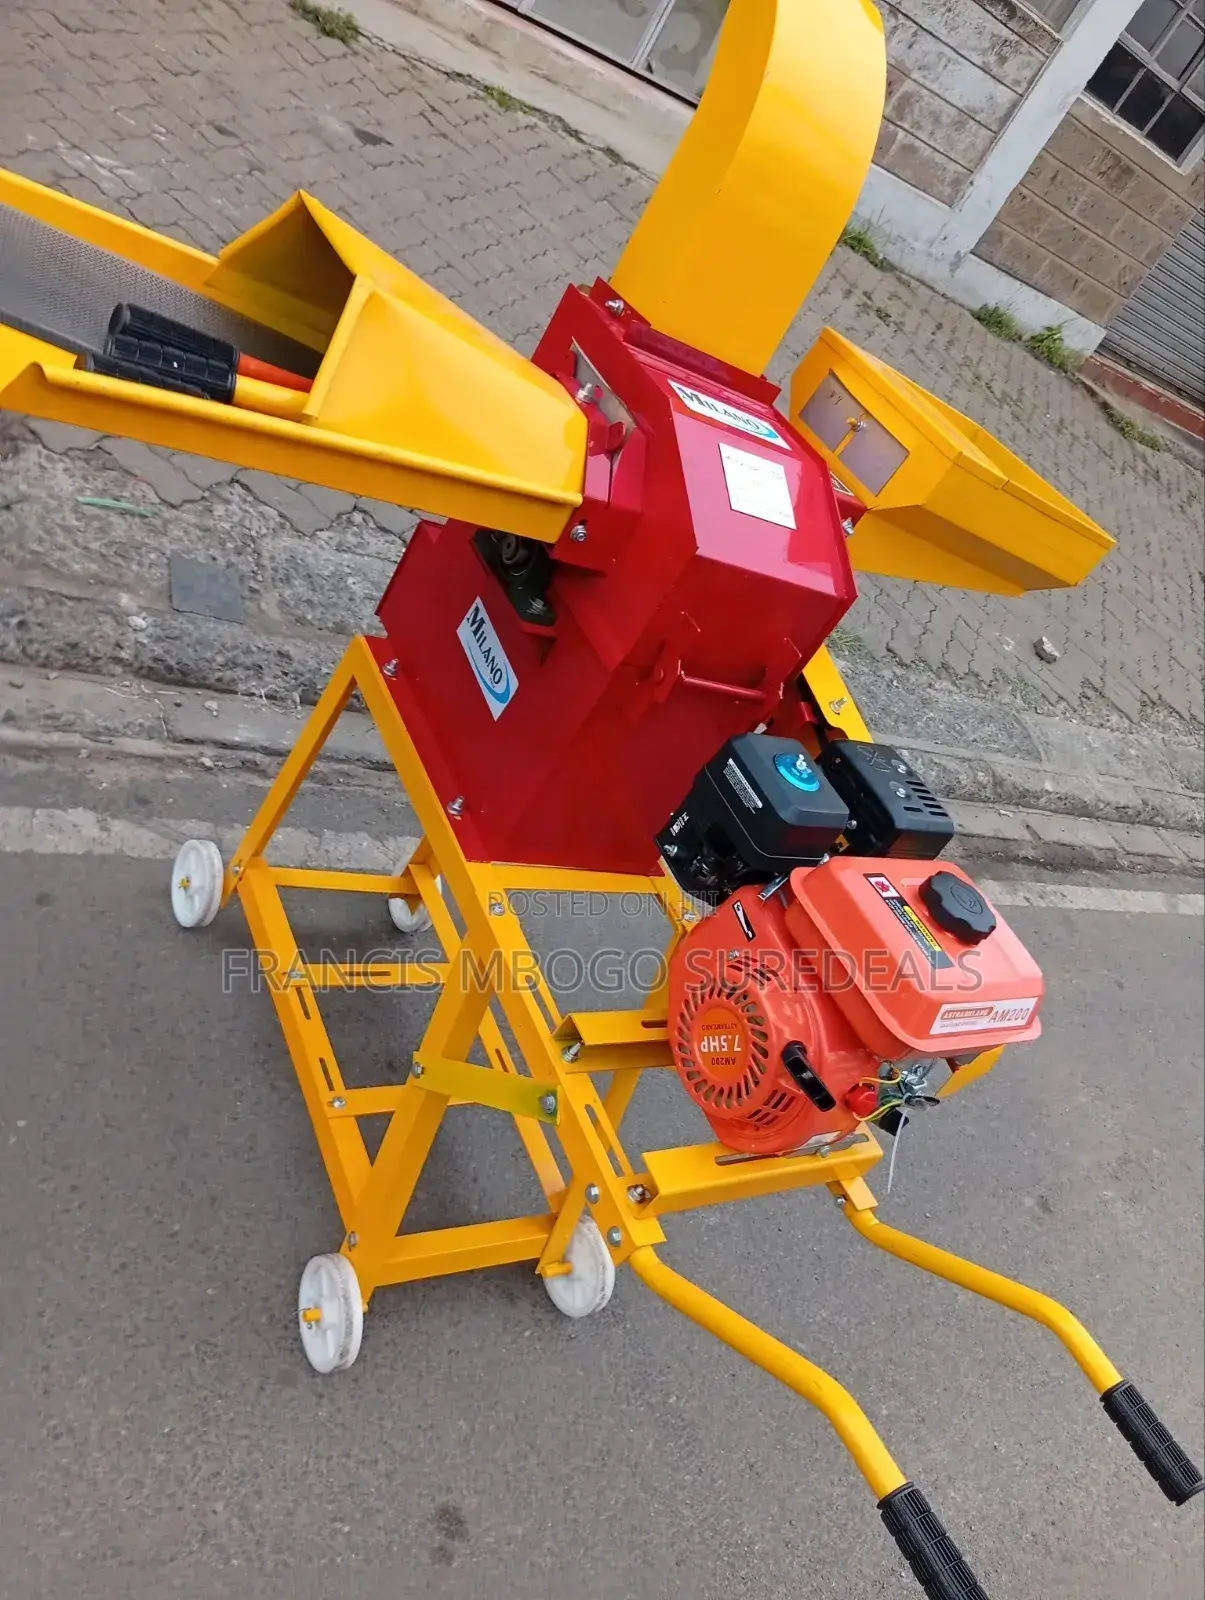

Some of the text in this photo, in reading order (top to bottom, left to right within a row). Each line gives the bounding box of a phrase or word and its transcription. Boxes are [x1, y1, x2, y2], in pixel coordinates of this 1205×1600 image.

[675, 385, 760, 430] MILANO
[466, 602, 503, 685] MILANO
[915, 919, 938, 948] WARNING
[988, 1006, 1030, 1024] AM200
[700, 1035, 742, 1053] 7.5HP
[711, 1056, 736, 1066] AM200
